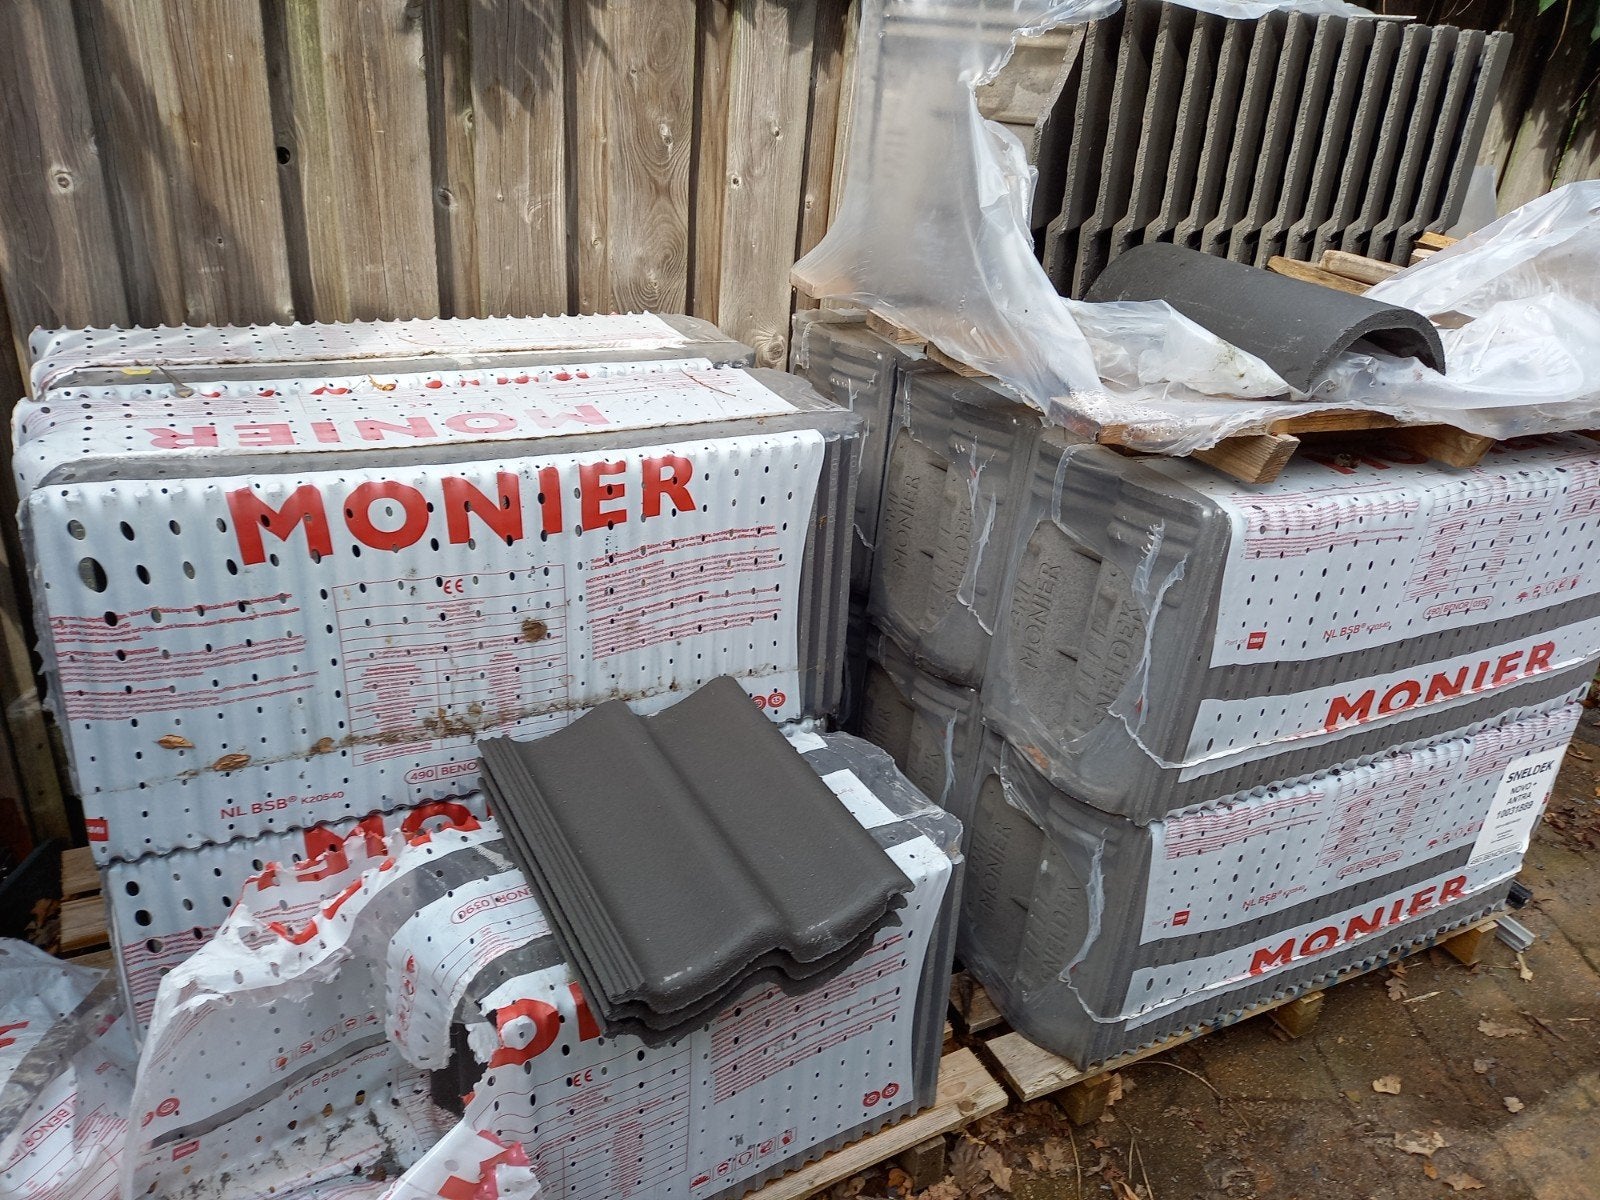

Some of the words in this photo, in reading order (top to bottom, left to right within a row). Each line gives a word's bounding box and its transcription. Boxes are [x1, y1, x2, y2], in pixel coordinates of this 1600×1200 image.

[144, 406, 610, 449] MONIER
[227, 454, 697, 566] MONIER
[892, 475, 920, 569] MONIER
[1020, 562, 1062, 670] MONIER
[1323, 629, 1338, 639] NL
[1323, 642, 1556, 734] MONIER
[410, 770, 435, 781] 490
[441, 761, 479, 776] BENO
[1506, 760, 1555, 783] SNELDEK
[1506, 792, 1532, 805] ANTRA
[1511, 782, 1531, 794] NOVO
[220, 806, 248, 820] NL
[1248, 875, 1467, 977] MONIER
